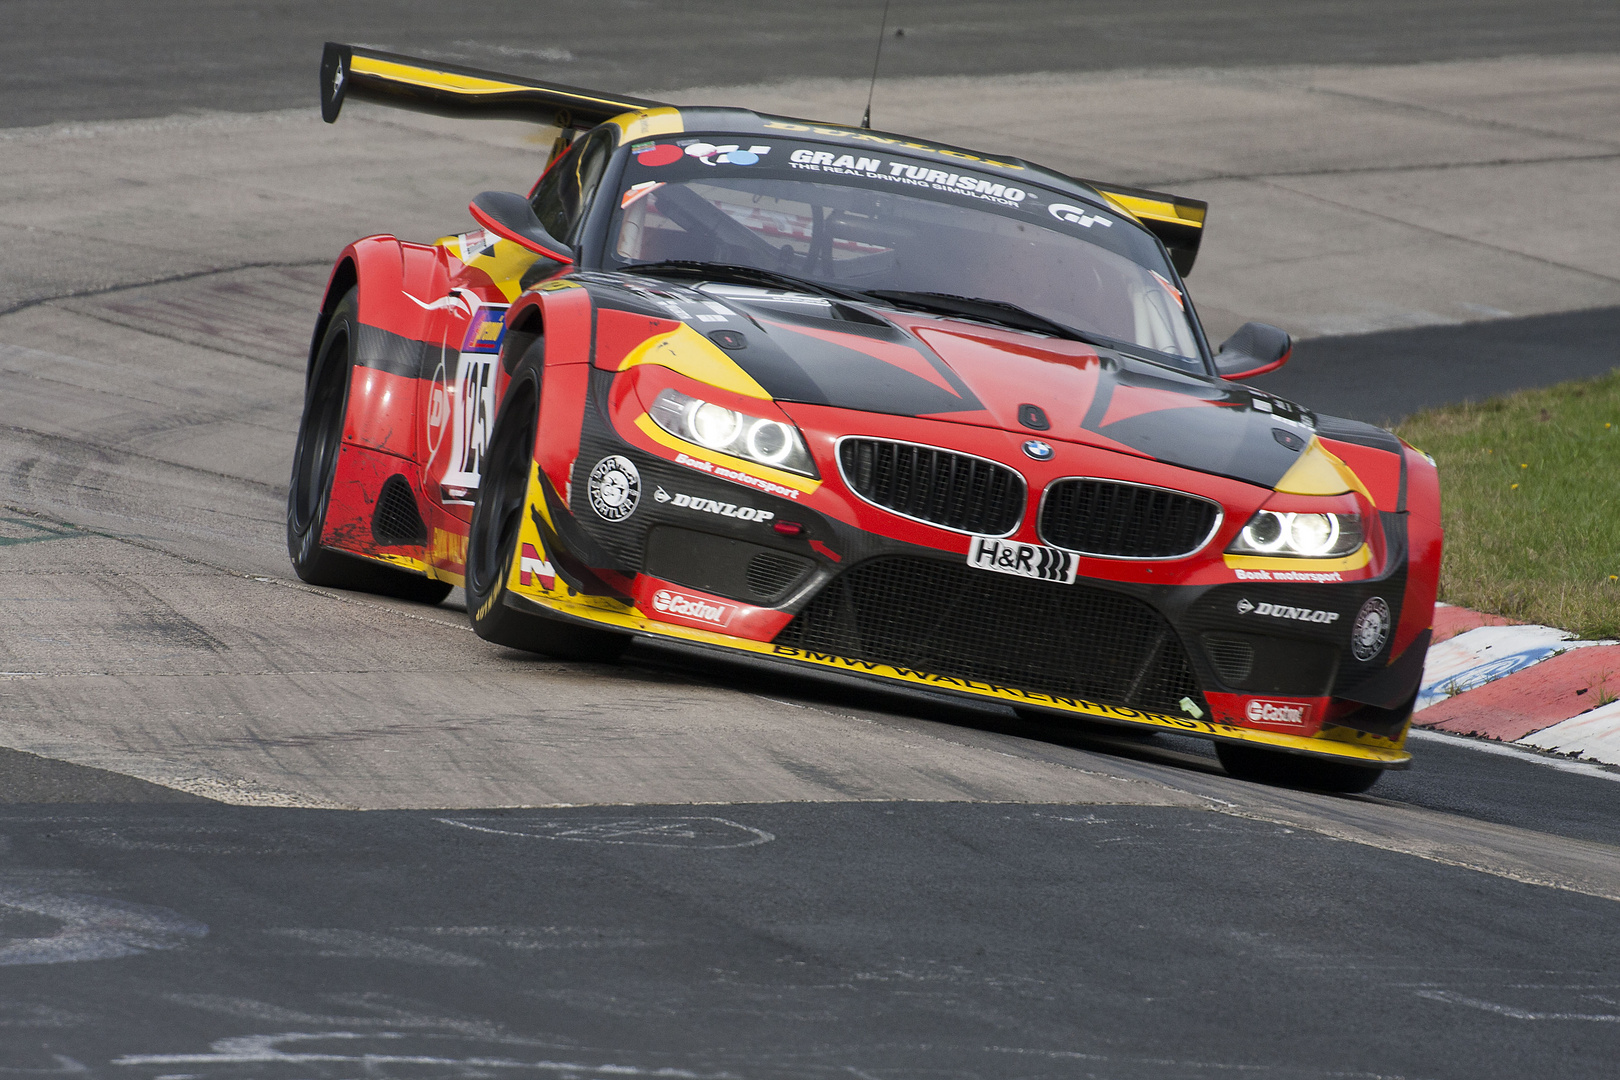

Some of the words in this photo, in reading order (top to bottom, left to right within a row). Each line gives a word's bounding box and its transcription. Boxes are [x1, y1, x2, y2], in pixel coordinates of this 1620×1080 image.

[764, 121, 1025, 171] DUNLOP
[788, 162, 820, 171] THE
[823, 165, 864, 177] REAL
[866, 171, 931, 188] DRIVING
[932, 183, 1020, 208] SIMULATOR
[790, 149, 881, 172] GRAN
[889, 161, 1026, 202] TURISMO
[674, 453, 714, 472] Bonk
[714, 466, 800, 499] motorsport
[670, 493, 775, 523] DUNLOP
[976, 539, 1034, 572] H&R
[1234, 569, 1273, 580] Bonk
[1272, 571, 1343, 584] motorsport
[668, 595, 726, 622] Castrol
[1253, 602, 1340, 624] DUNLOP
[775, 645, 878, 670] BMW
[890, 664, 1217, 734] WALKENHORST
[1262, 703, 1304, 724] Castrol
